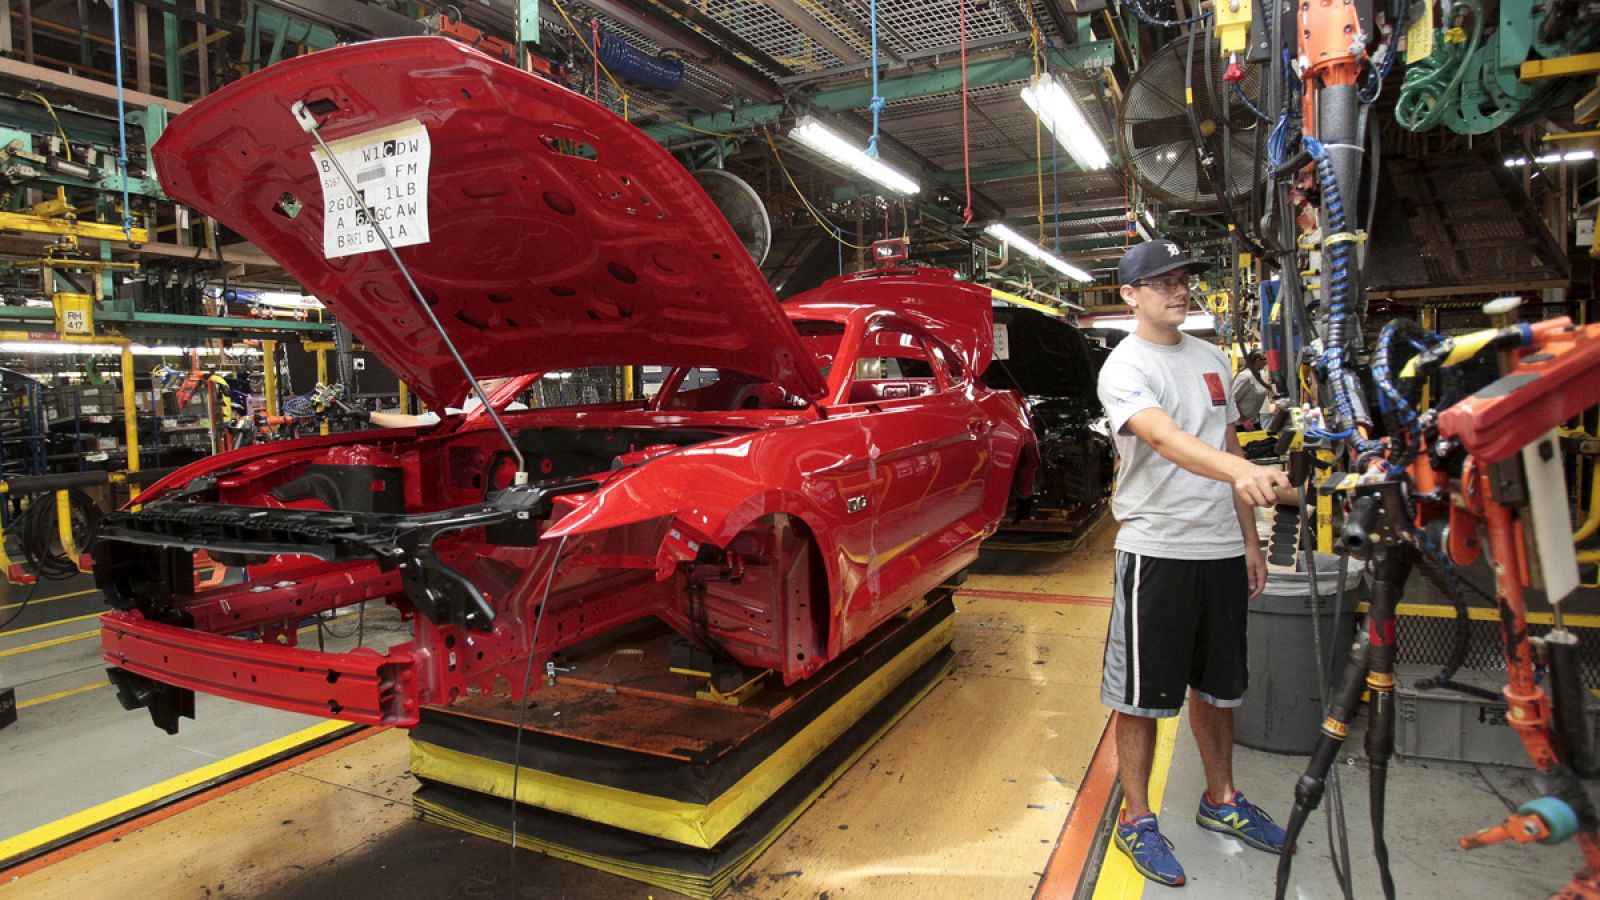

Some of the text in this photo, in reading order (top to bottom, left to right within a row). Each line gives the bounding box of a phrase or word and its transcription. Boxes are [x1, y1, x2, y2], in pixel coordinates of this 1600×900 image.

[321, 159, 331, 173] B
[337, 216, 345, 229] A
[337, 235, 345, 248] B
[367, 230, 376, 243] B
